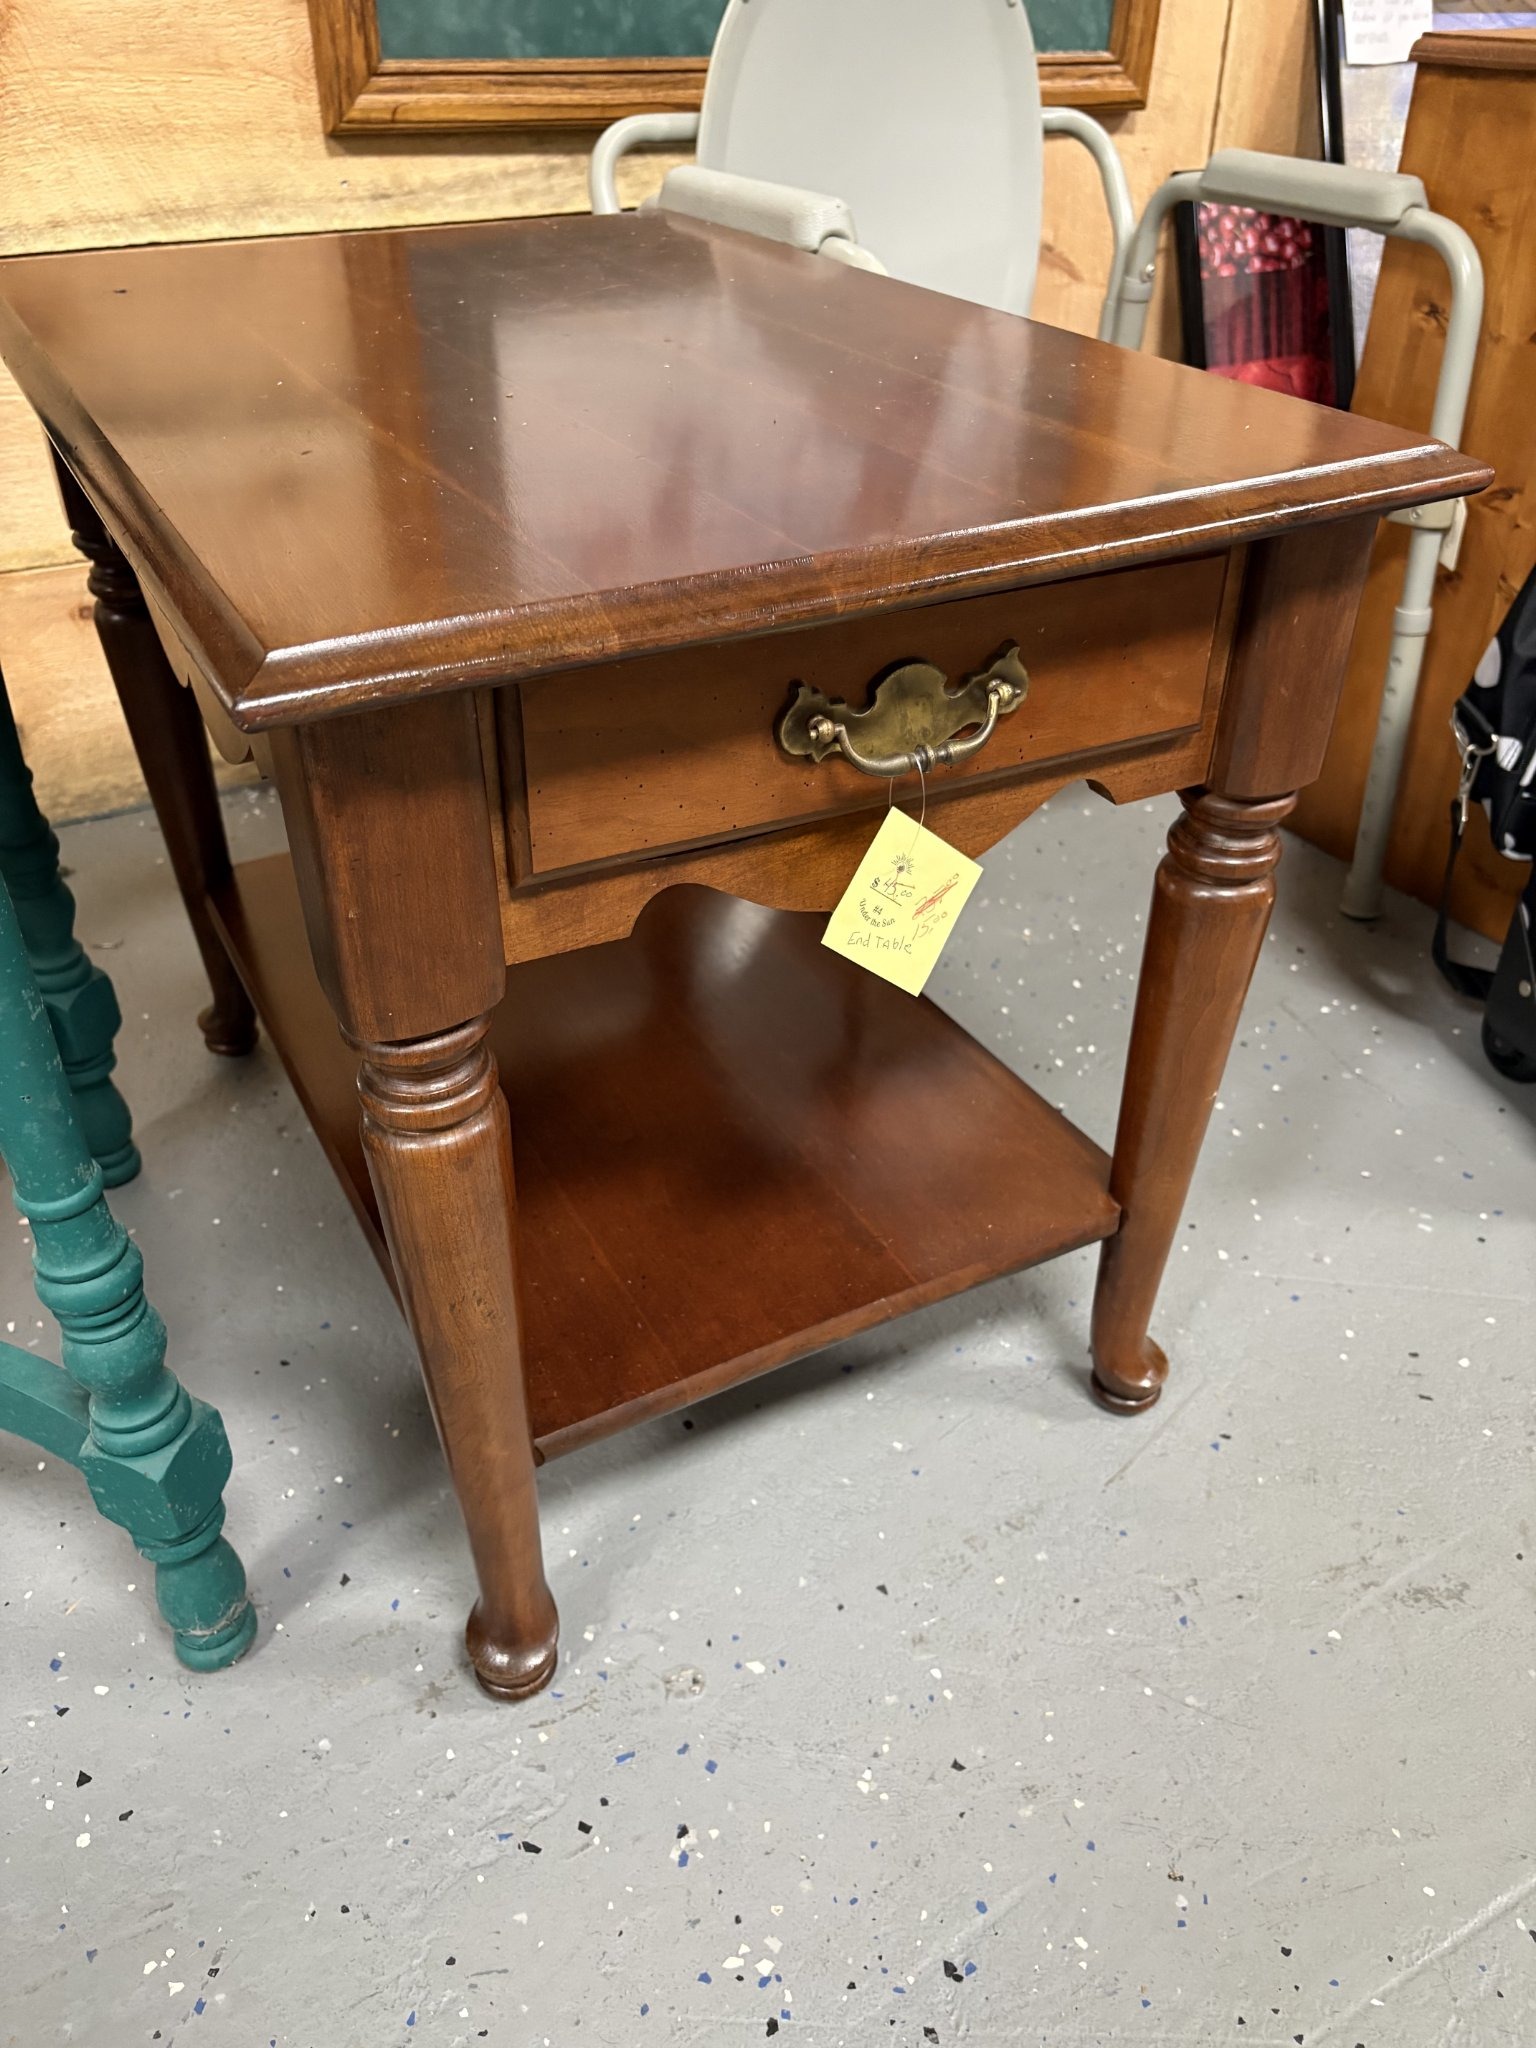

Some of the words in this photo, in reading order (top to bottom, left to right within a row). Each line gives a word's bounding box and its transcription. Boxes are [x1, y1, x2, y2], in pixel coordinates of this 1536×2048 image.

[859, 898, 871, 922] Under
[870, 919, 881, 928] the
[881, 918, 896, 928] Sun
[847, 931, 872, 948] End
